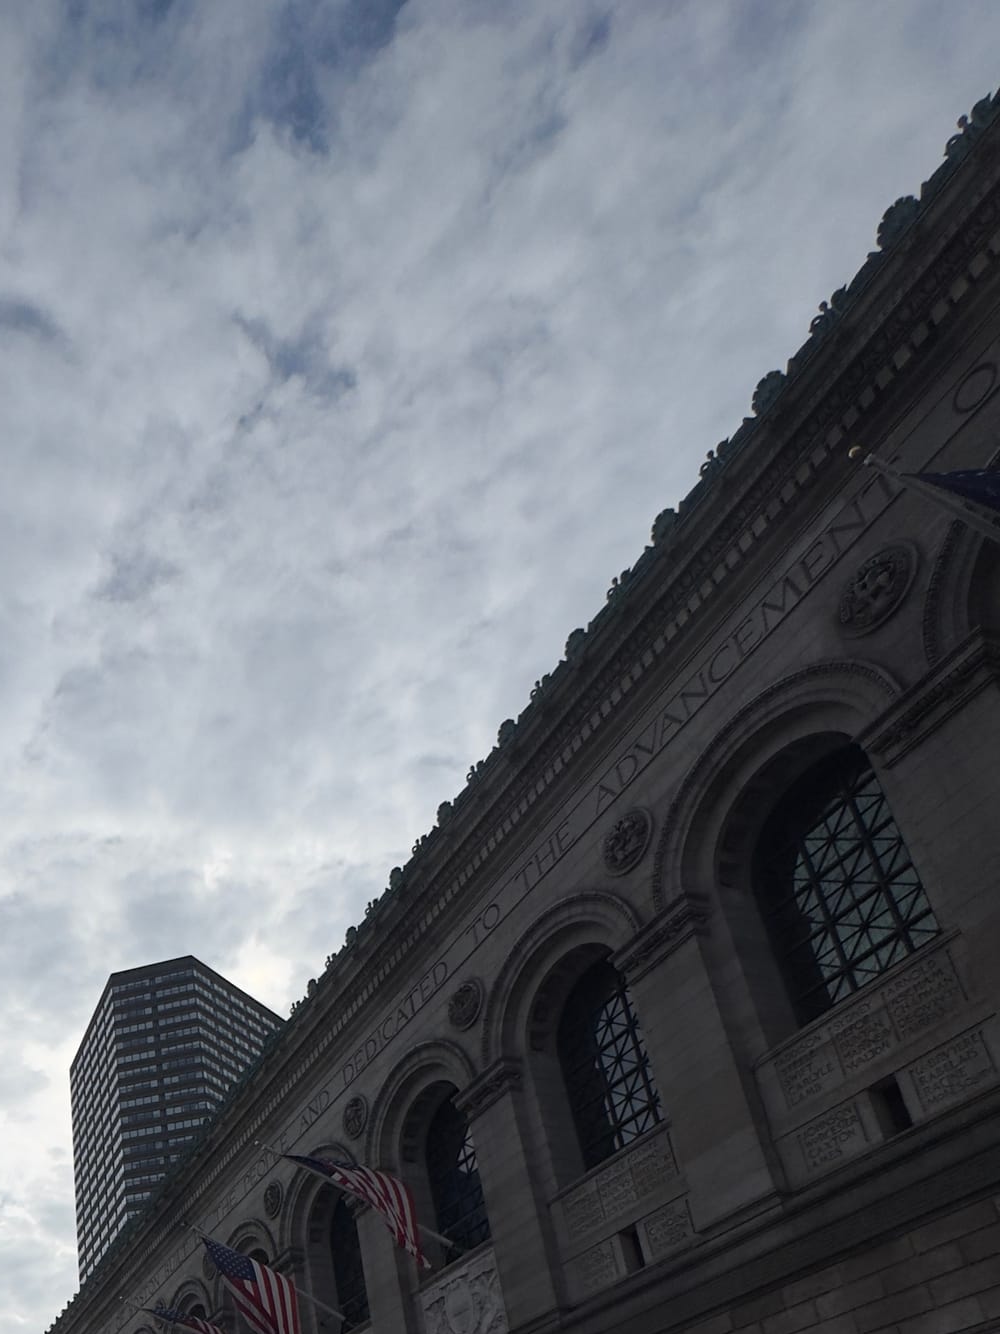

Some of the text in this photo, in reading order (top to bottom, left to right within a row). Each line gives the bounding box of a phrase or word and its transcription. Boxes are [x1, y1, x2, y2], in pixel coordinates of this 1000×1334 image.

[297, 1089, 331, 1133] AND
[340, 959, 449, 1085] DEDICATED
[464, 902, 501, 946] TO
[513, 818, 578, 888] THE
[592, 455, 900, 815] ADVANCEMENT
